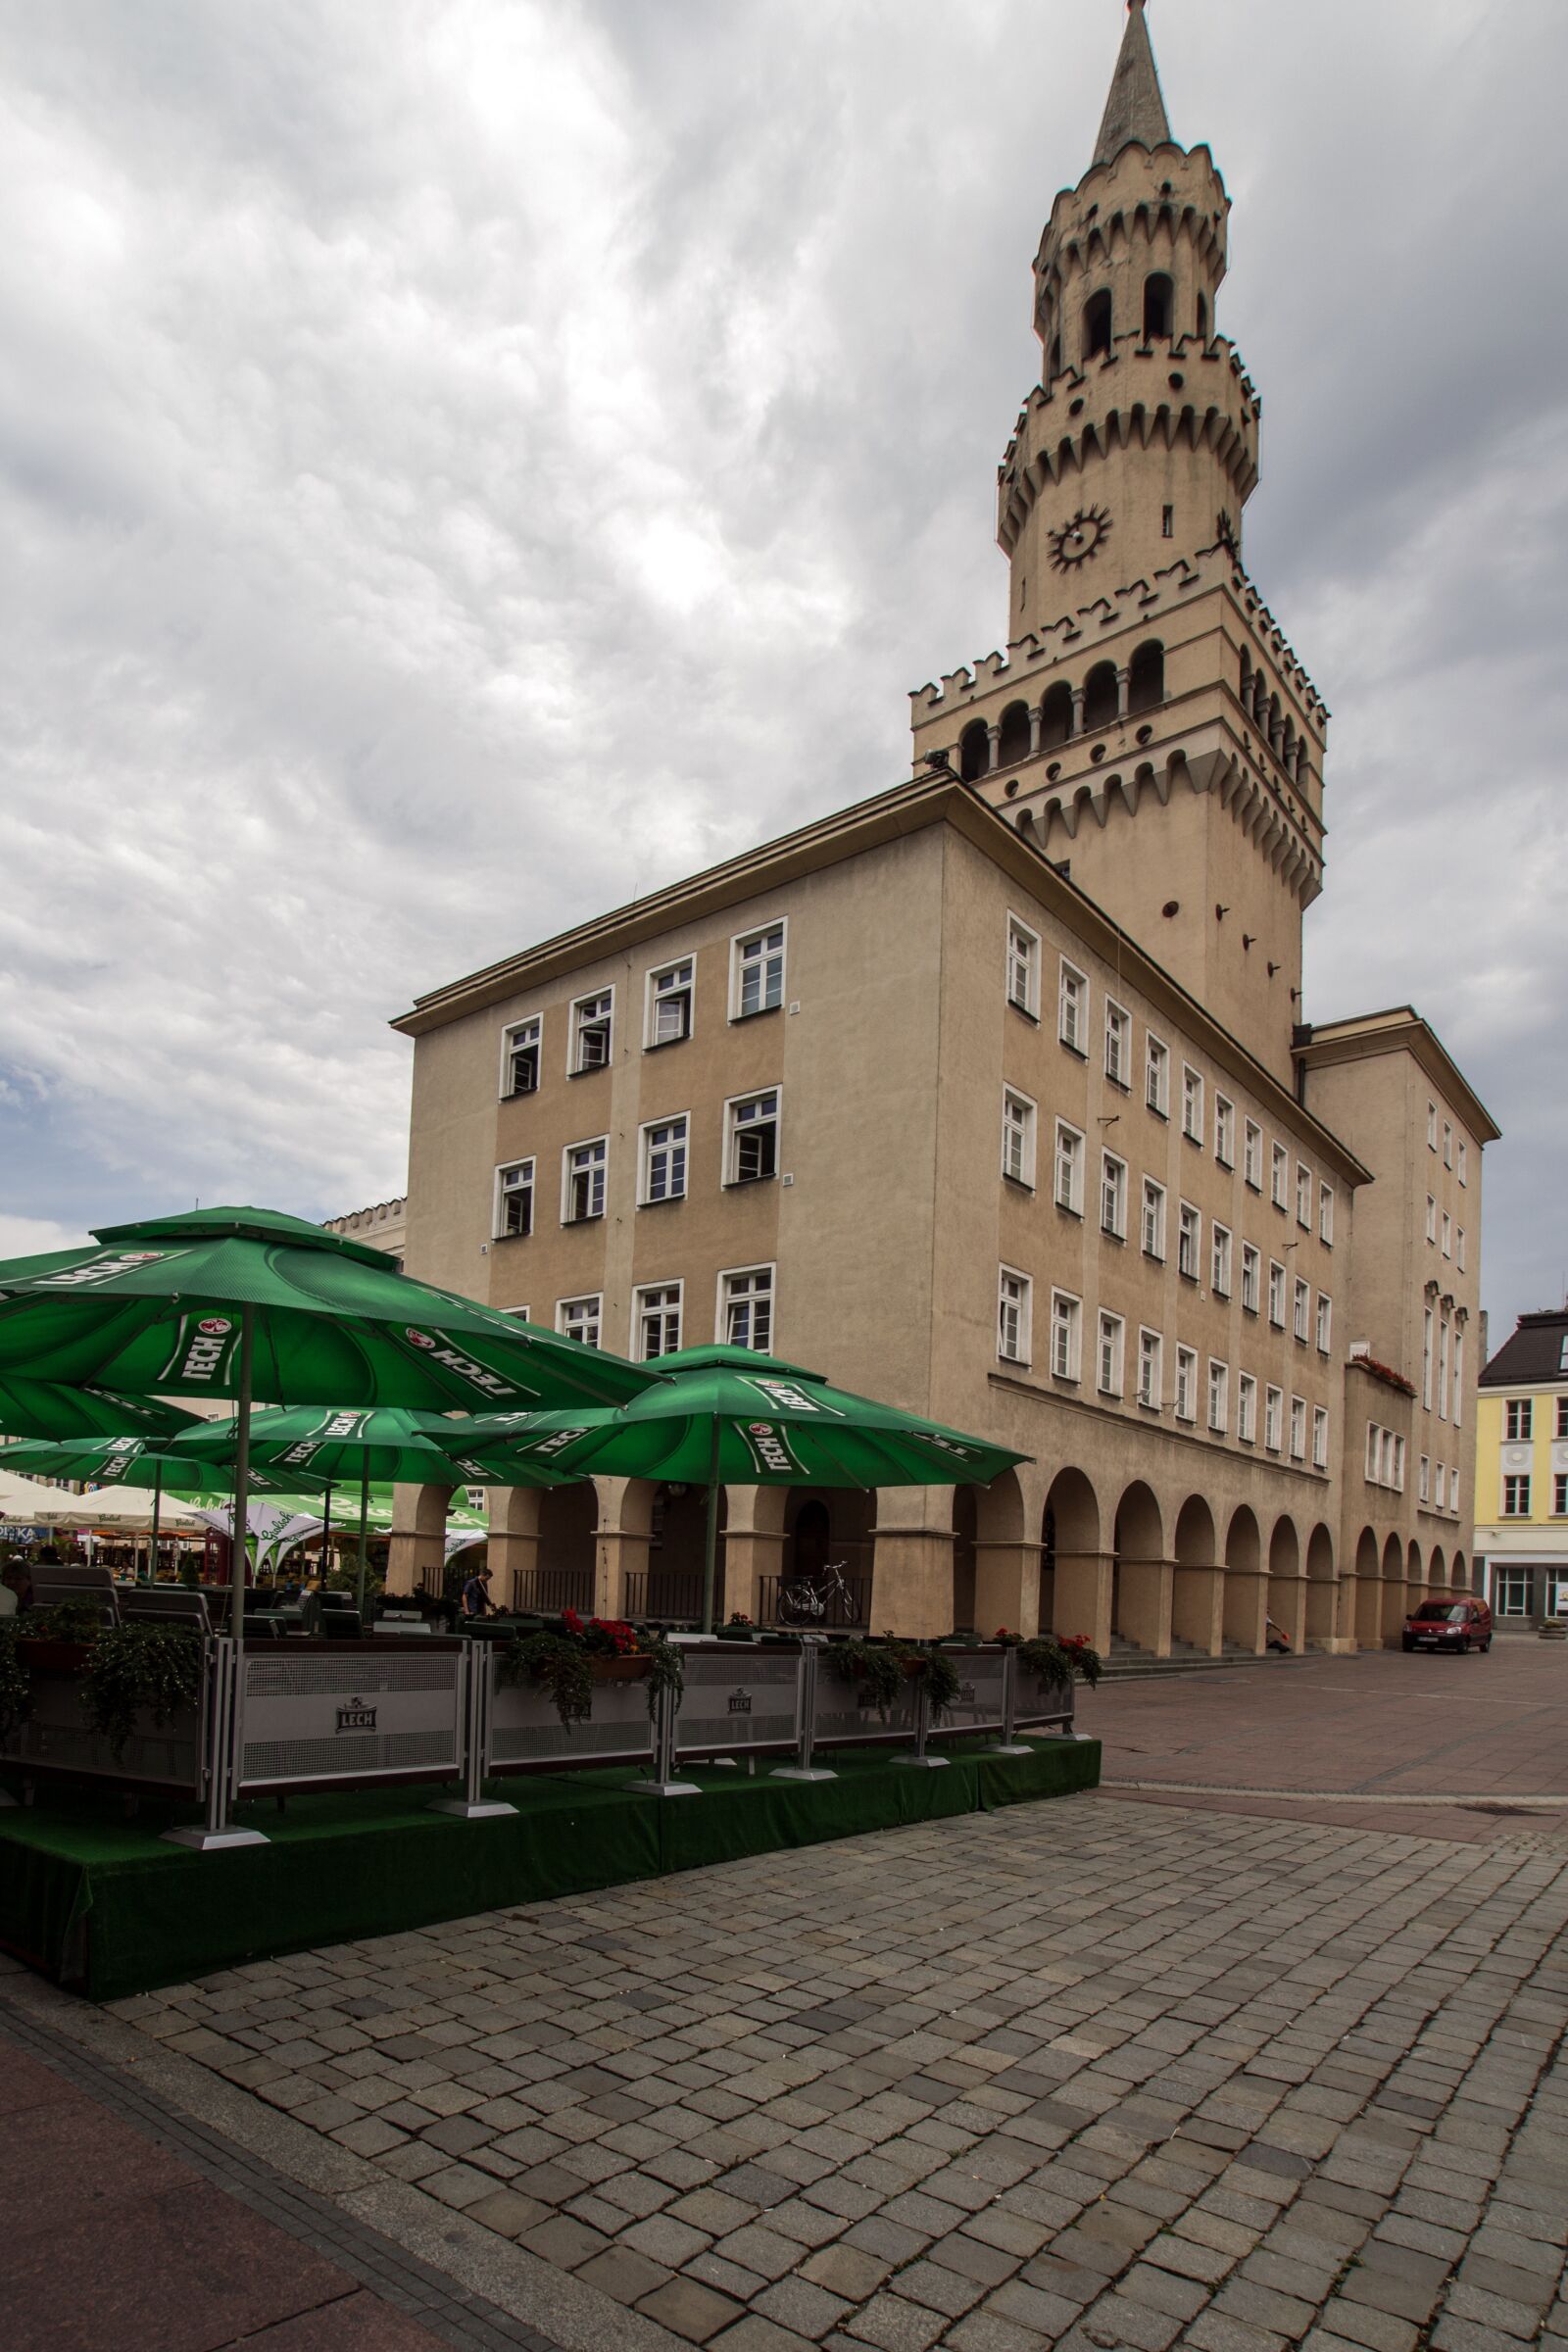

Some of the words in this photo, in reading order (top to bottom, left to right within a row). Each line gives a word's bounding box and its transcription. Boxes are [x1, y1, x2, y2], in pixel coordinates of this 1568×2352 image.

[30, 1261, 143, 1285] LECH
[764, 1388, 820, 1411] LECH
[324, 1417, 358, 1436] LECH
[260, 1511, 293, 1541] Grolsch
[730, 1698, 751, 1711] LECH
[340, 1711, 374, 1728] LECH
